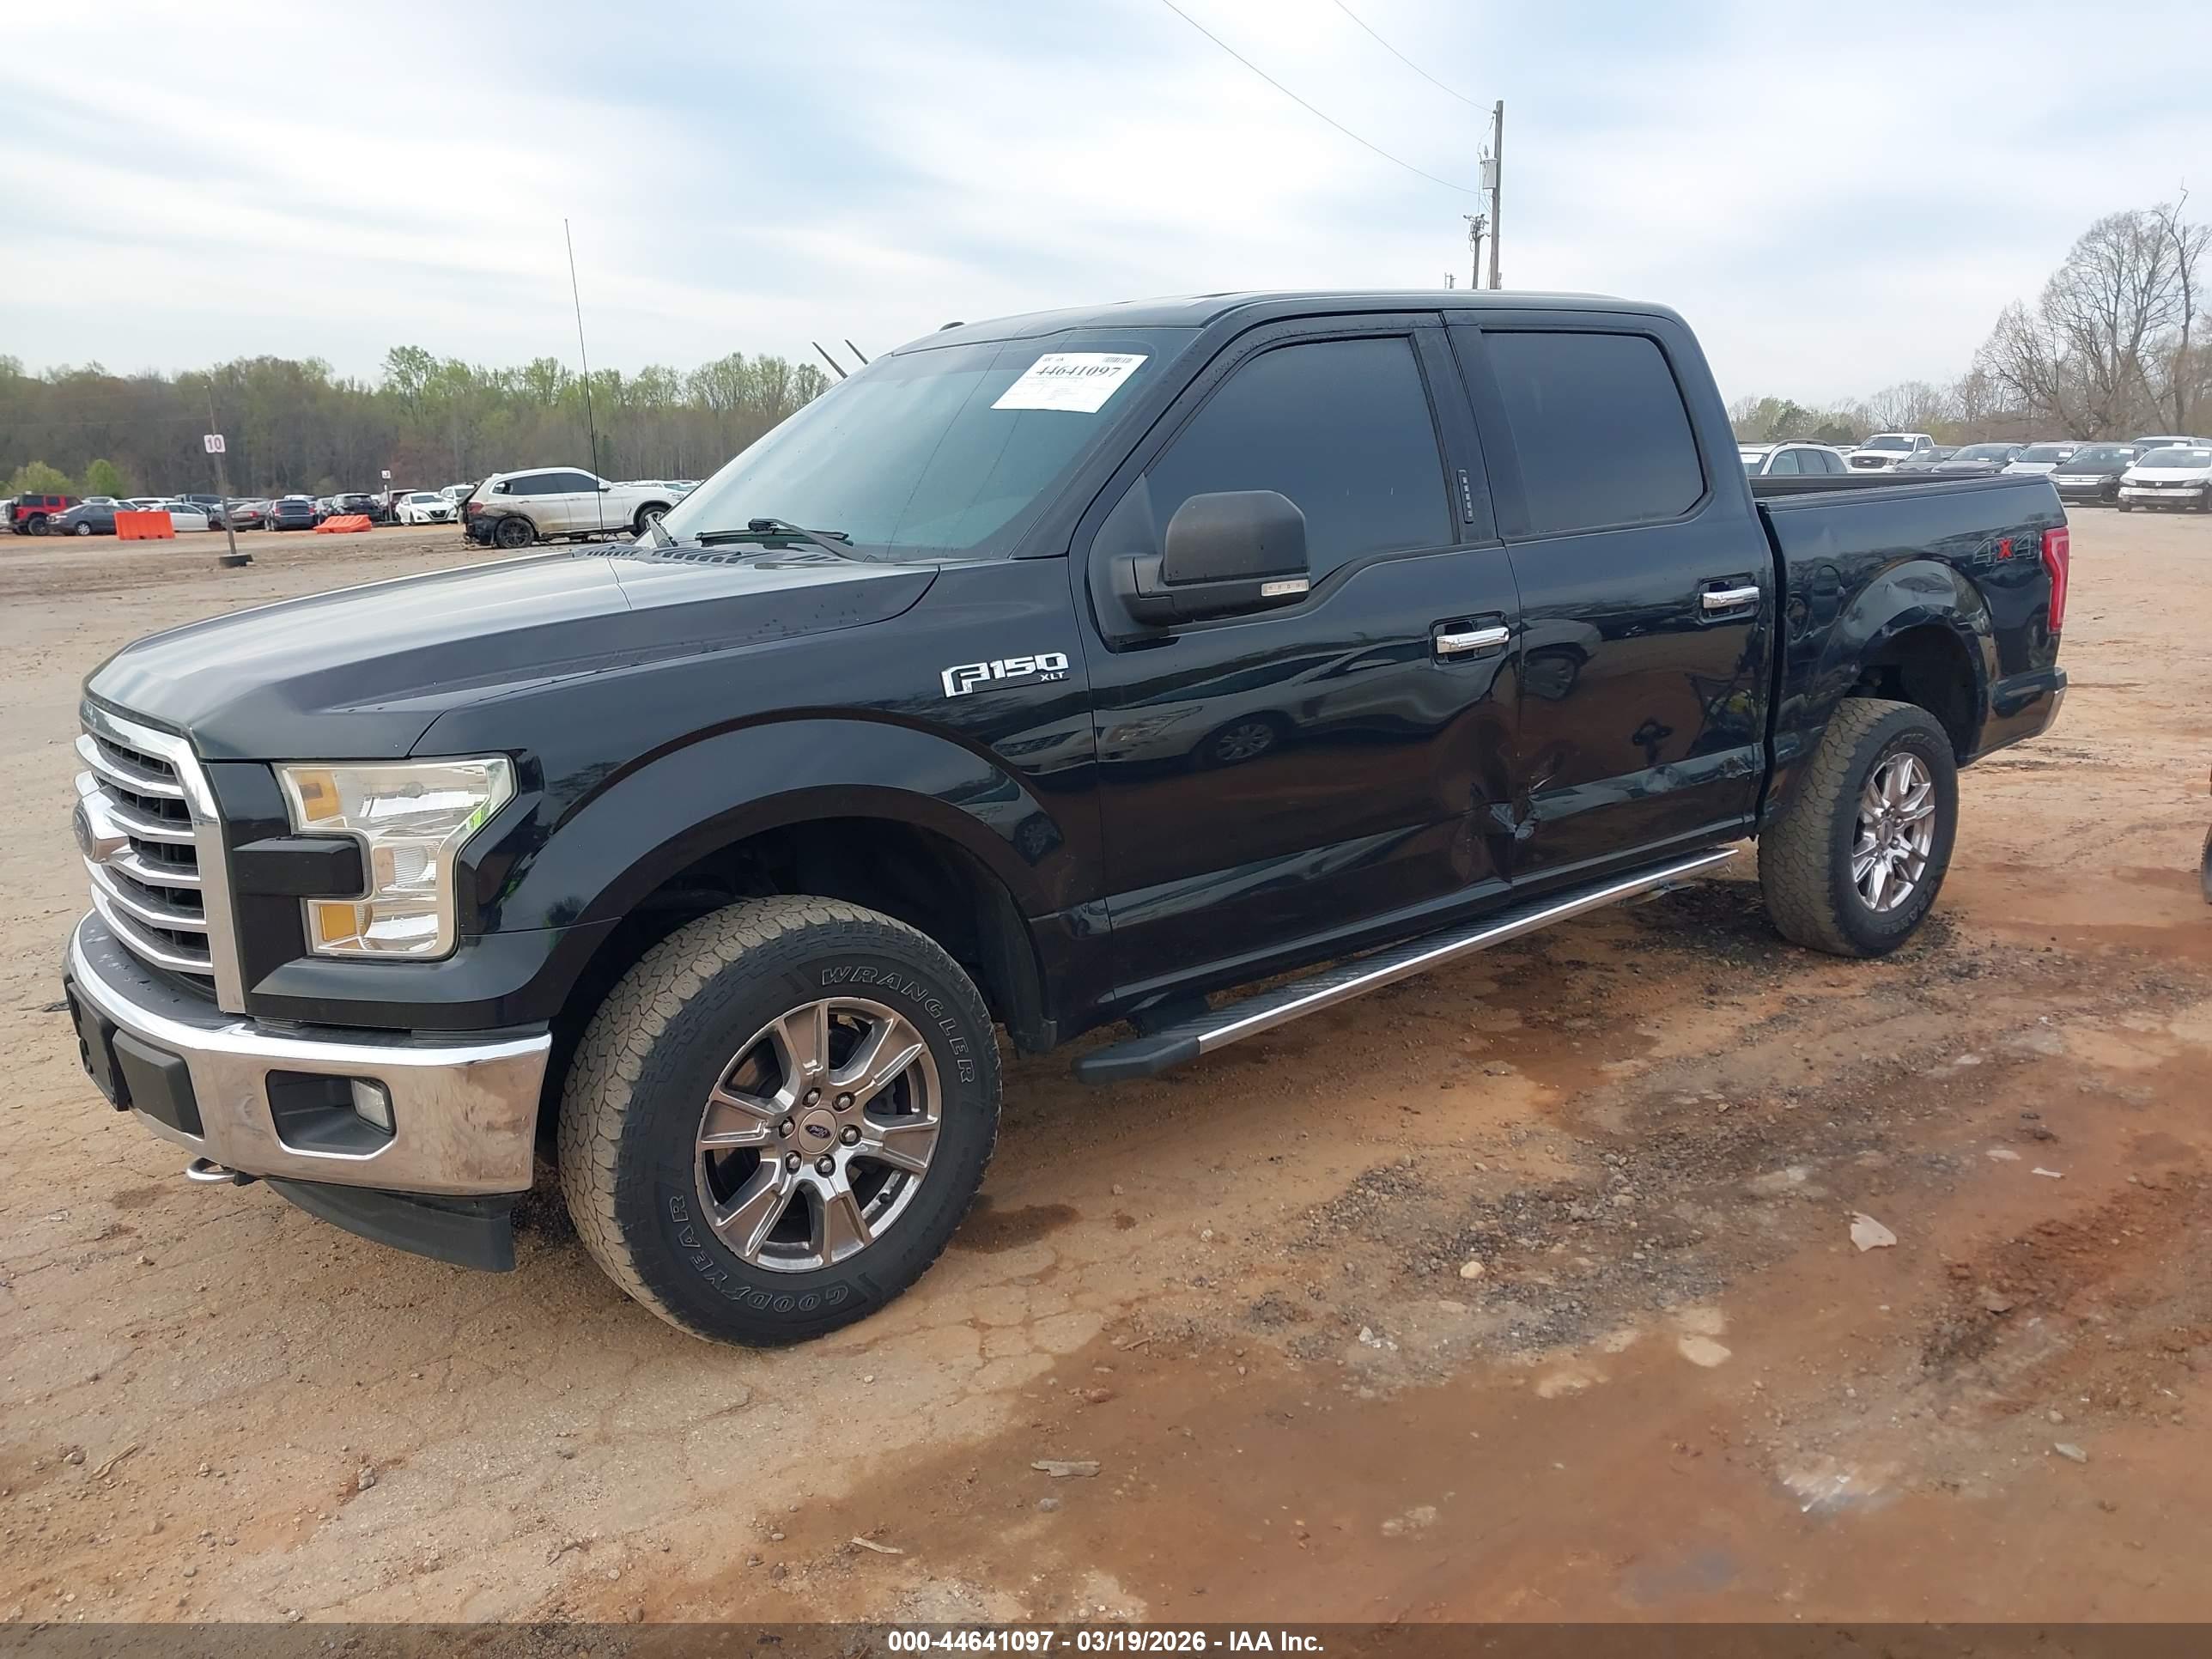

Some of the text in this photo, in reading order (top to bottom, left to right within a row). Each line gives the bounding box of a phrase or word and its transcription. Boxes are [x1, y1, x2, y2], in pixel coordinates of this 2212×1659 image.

[1036, 365, 1122, 377] 44641097
[208, 437, 222, 450] 10
[1040, 671, 1065, 682] XLT
[821, 965, 975, 1084] WRANGLER
[668, 1194, 850, 1313] GOODYEAR
